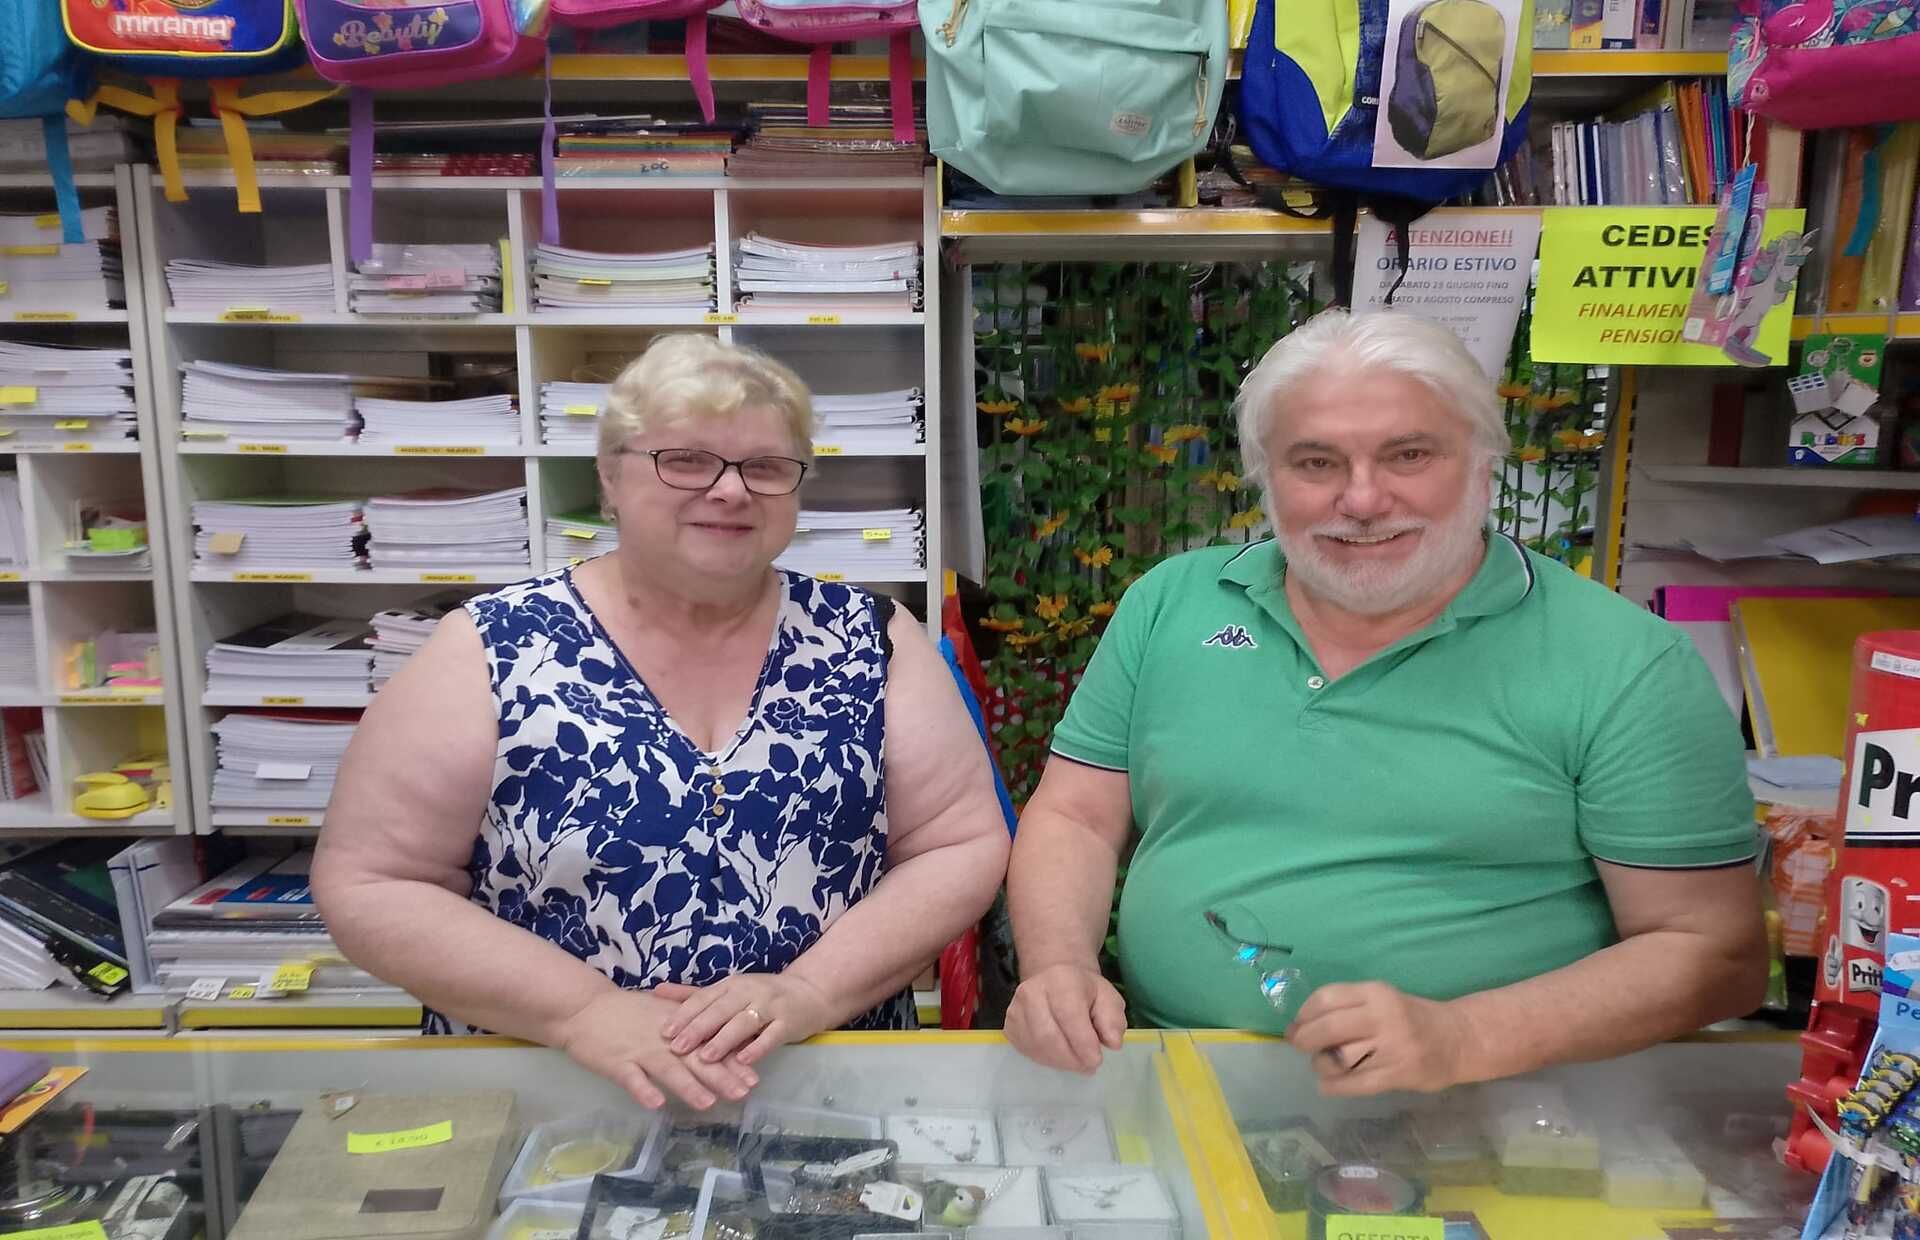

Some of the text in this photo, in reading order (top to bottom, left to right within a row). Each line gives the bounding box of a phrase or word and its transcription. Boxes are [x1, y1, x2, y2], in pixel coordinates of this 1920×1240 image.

[113, 13, 231, 40] MITAMA
[1385, 229, 1513, 246] ATENZIONE!!
[1602, 224, 1714, 247] CEDES
[1454, 257, 1517, 271] ESTIVO
[1399, 281, 1431, 289] ABATO
[1486, 281, 1509, 289] FINO
[1573, 266, 1696, 288] ATTIVI
[1578, 303, 1687, 318] FINALMEN
